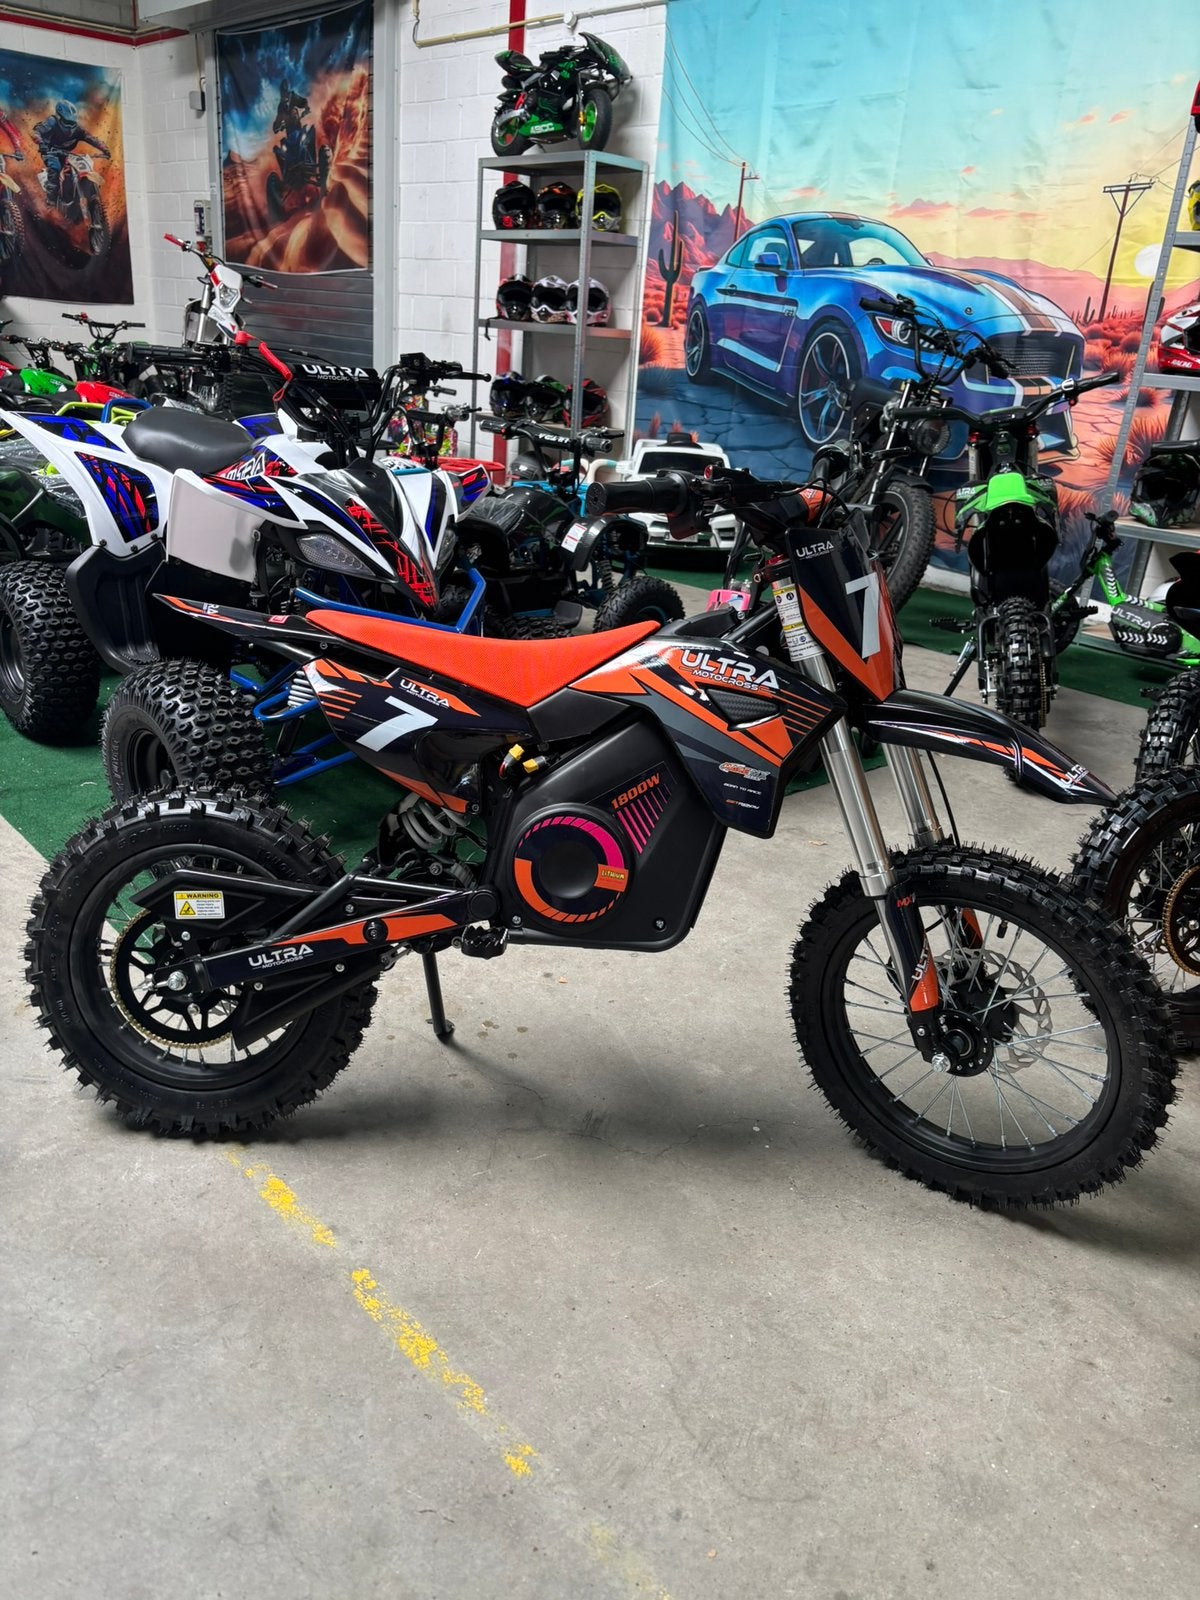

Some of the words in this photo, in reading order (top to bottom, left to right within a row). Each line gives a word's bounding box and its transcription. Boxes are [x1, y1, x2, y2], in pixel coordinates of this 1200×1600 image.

[302, 363, 370, 378] ULTRA
[796, 540, 835, 558] ULTRA
[845, 571, 881, 660] 7
[681, 649, 780, 690] ULTRA
[692, 669, 759, 692] MOTOCROSS
[400, 679, 450, 708] ULTRA
[356, 695, 439, 752] 7
[611, 773, 660, 809] 1800W
[248, 943, 314, 967] ULTRA
[261, 955, 304, 969] MOTOCROSS
